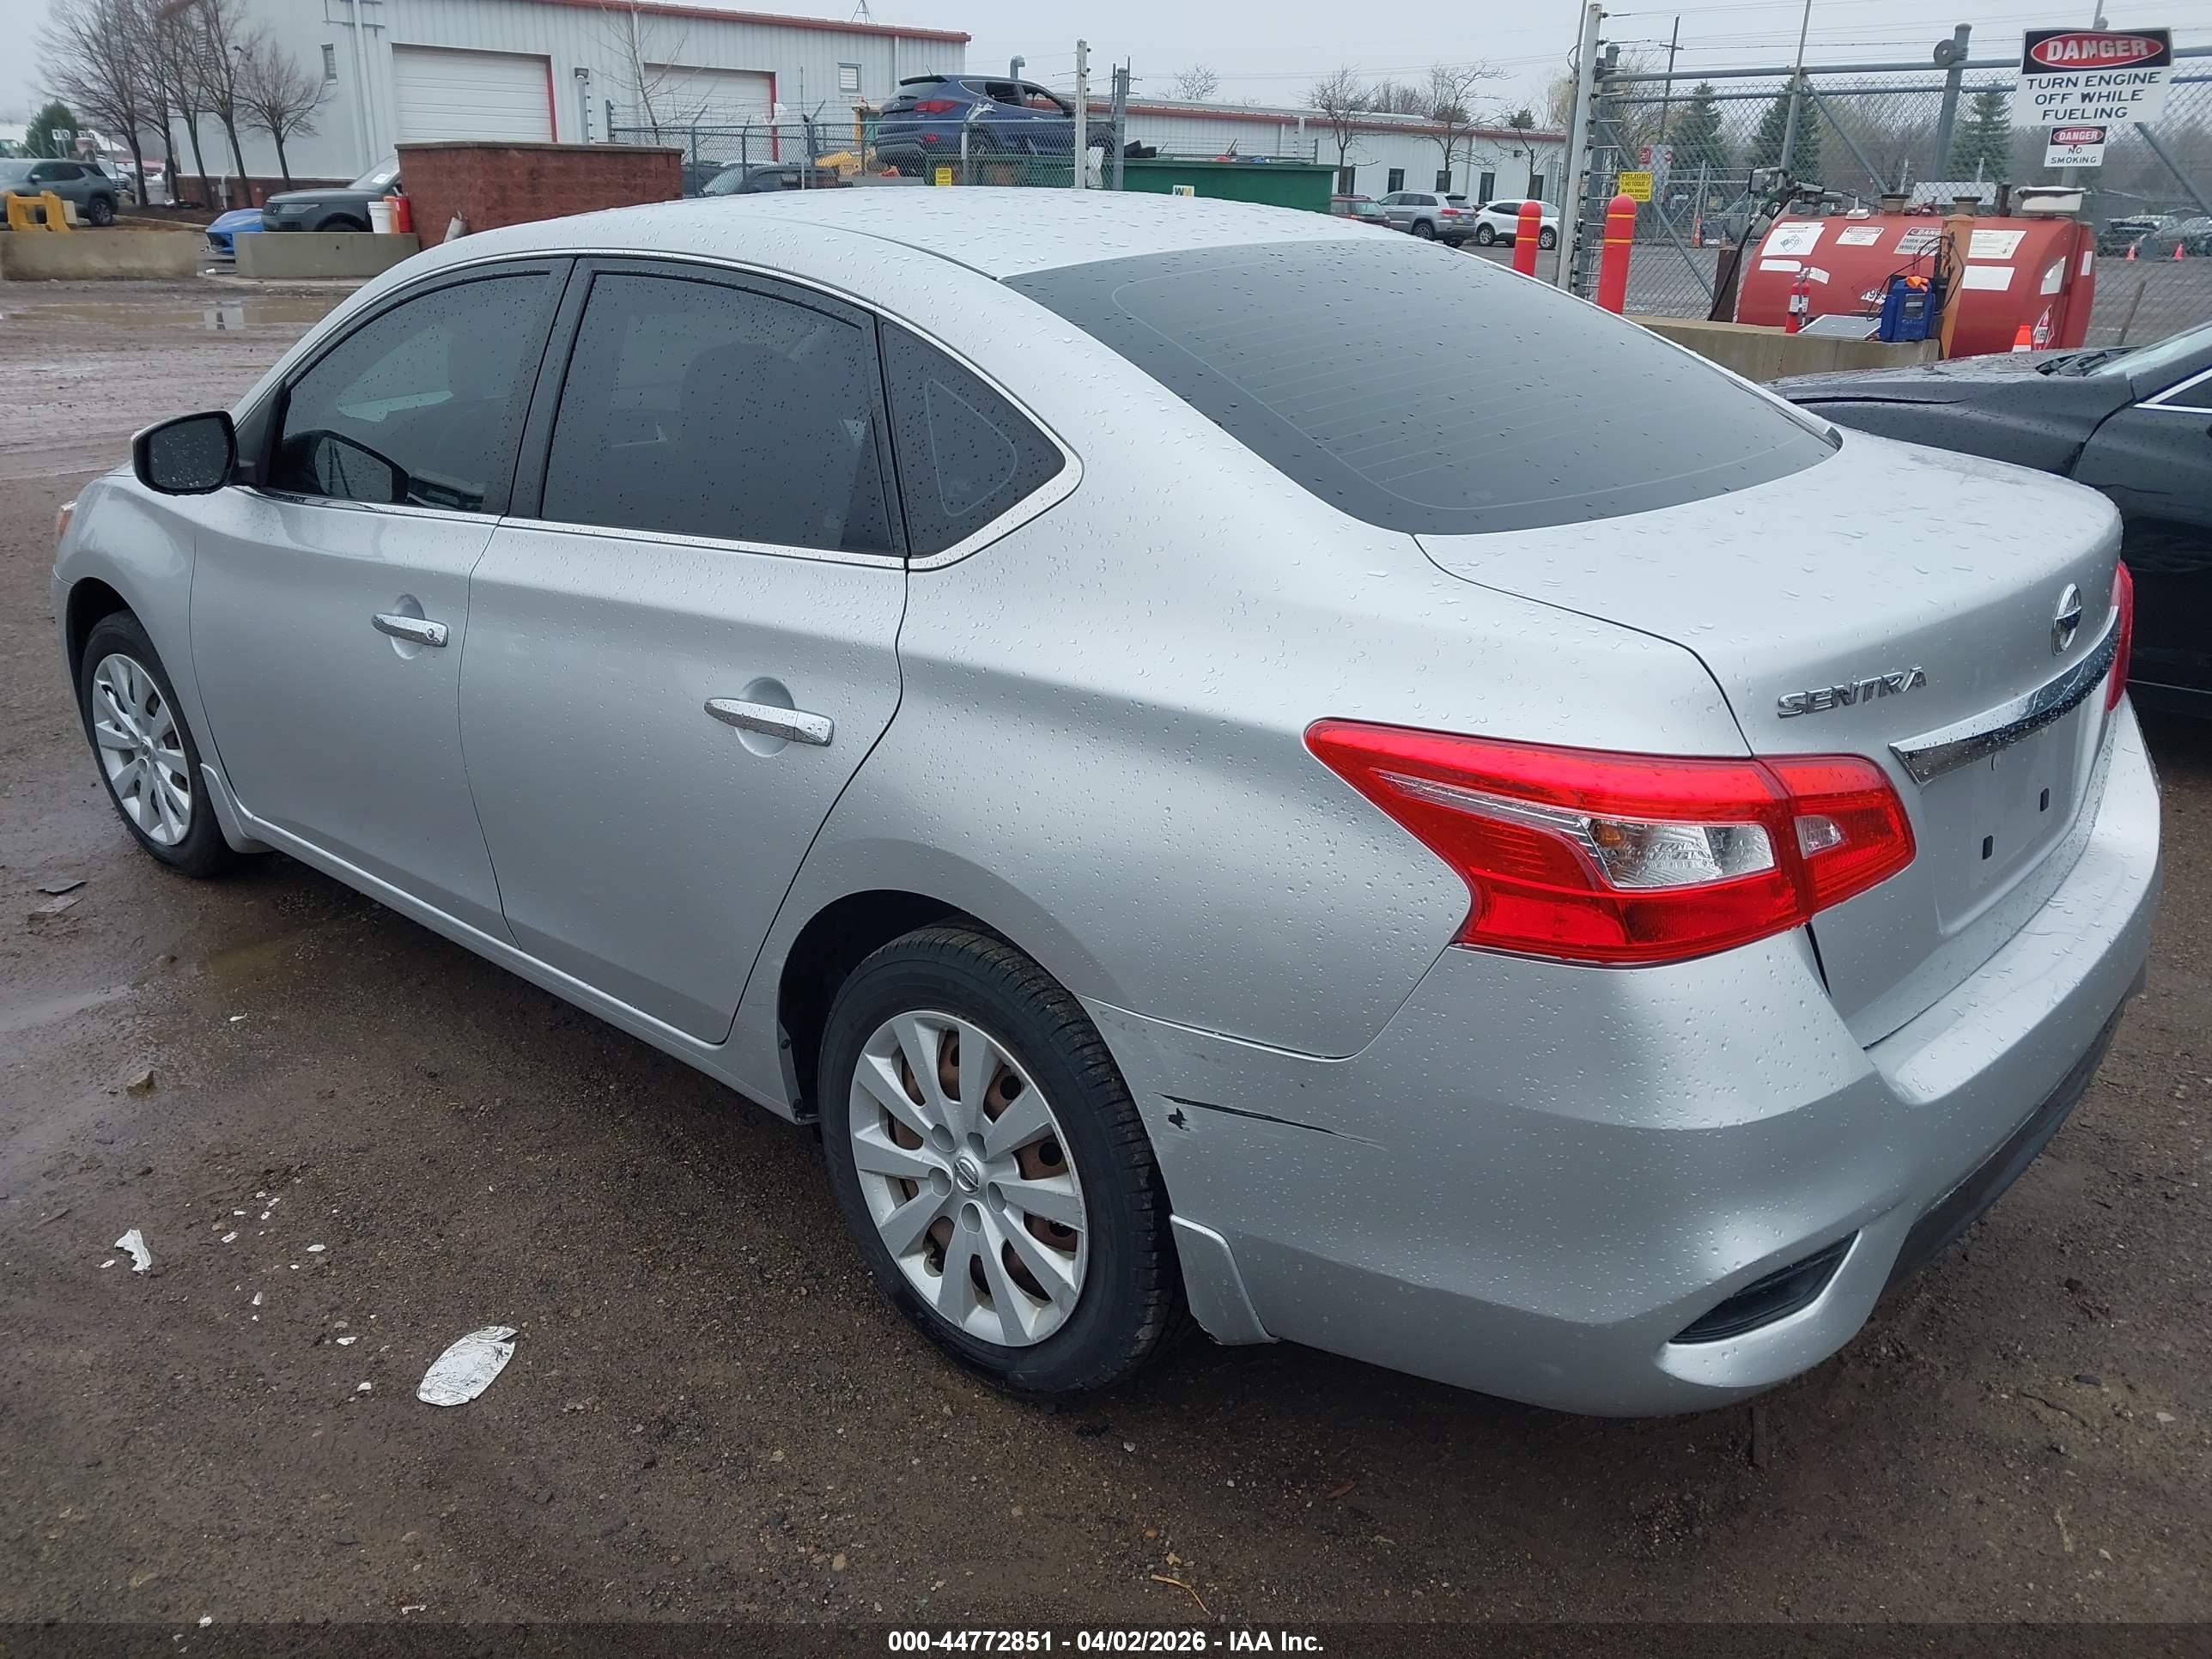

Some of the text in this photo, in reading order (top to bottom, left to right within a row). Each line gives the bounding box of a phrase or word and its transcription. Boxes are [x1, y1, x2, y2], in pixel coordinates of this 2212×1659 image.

[2046, 40, 2148, 62] DANGER
[2027, 71, 2161, 90] TURN ENGINE
[2034, 89, 2145, 106] OFF WHILE
[2042, 106, 2128, 121] FUELING
[2059, 131, 2098, 141] DANGER
[1778, 666, 1927, 719] SENTRA
